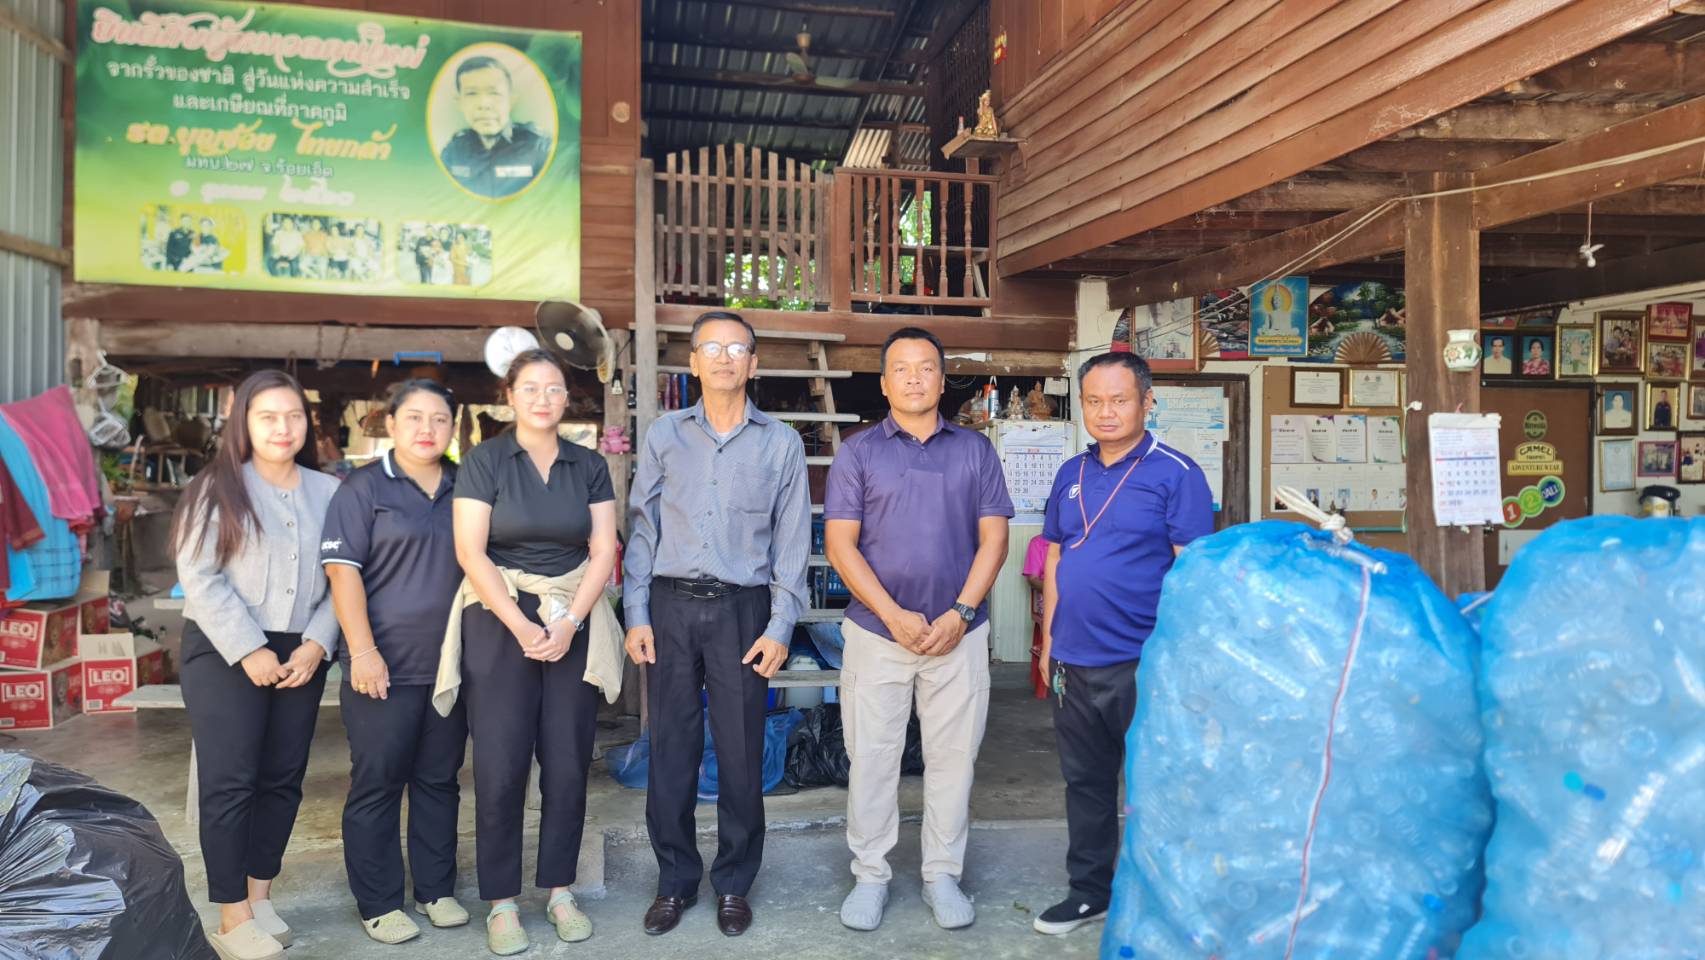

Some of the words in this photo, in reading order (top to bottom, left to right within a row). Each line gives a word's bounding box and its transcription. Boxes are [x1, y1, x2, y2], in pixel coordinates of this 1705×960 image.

[107, 54, 235, 85] จากรั้วของชาติ
[242, 66, 411, 100] สู่วันแห่งความสำเร็จ
[172, 91, 347, 127] และเกษียณที่ภาคภูมิ
[1520, 445, 1552, 456] CAMEL
[0, 622, 32, 635] LEO
[93, 668, 126, 683] LEO
[5, 683, 40, 698] LEO
